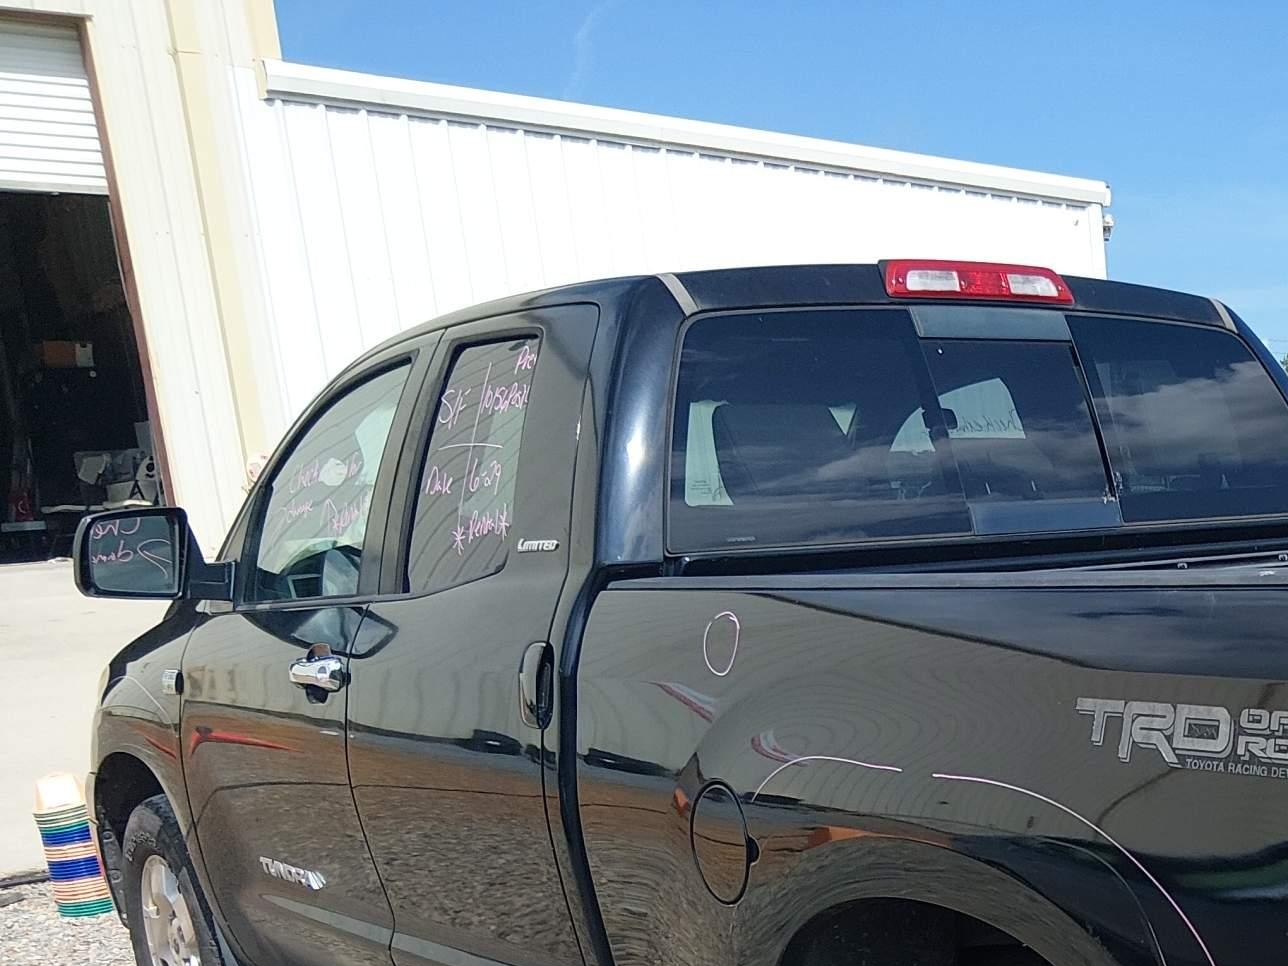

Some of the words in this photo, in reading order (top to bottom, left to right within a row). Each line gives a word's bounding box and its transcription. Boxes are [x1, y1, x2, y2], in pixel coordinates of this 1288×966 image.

[1075, 697, 1235, 768] TRD
[1185, 758, 1226, 774] TOYOTA
[1227, 761, 1269, 778] RACING
